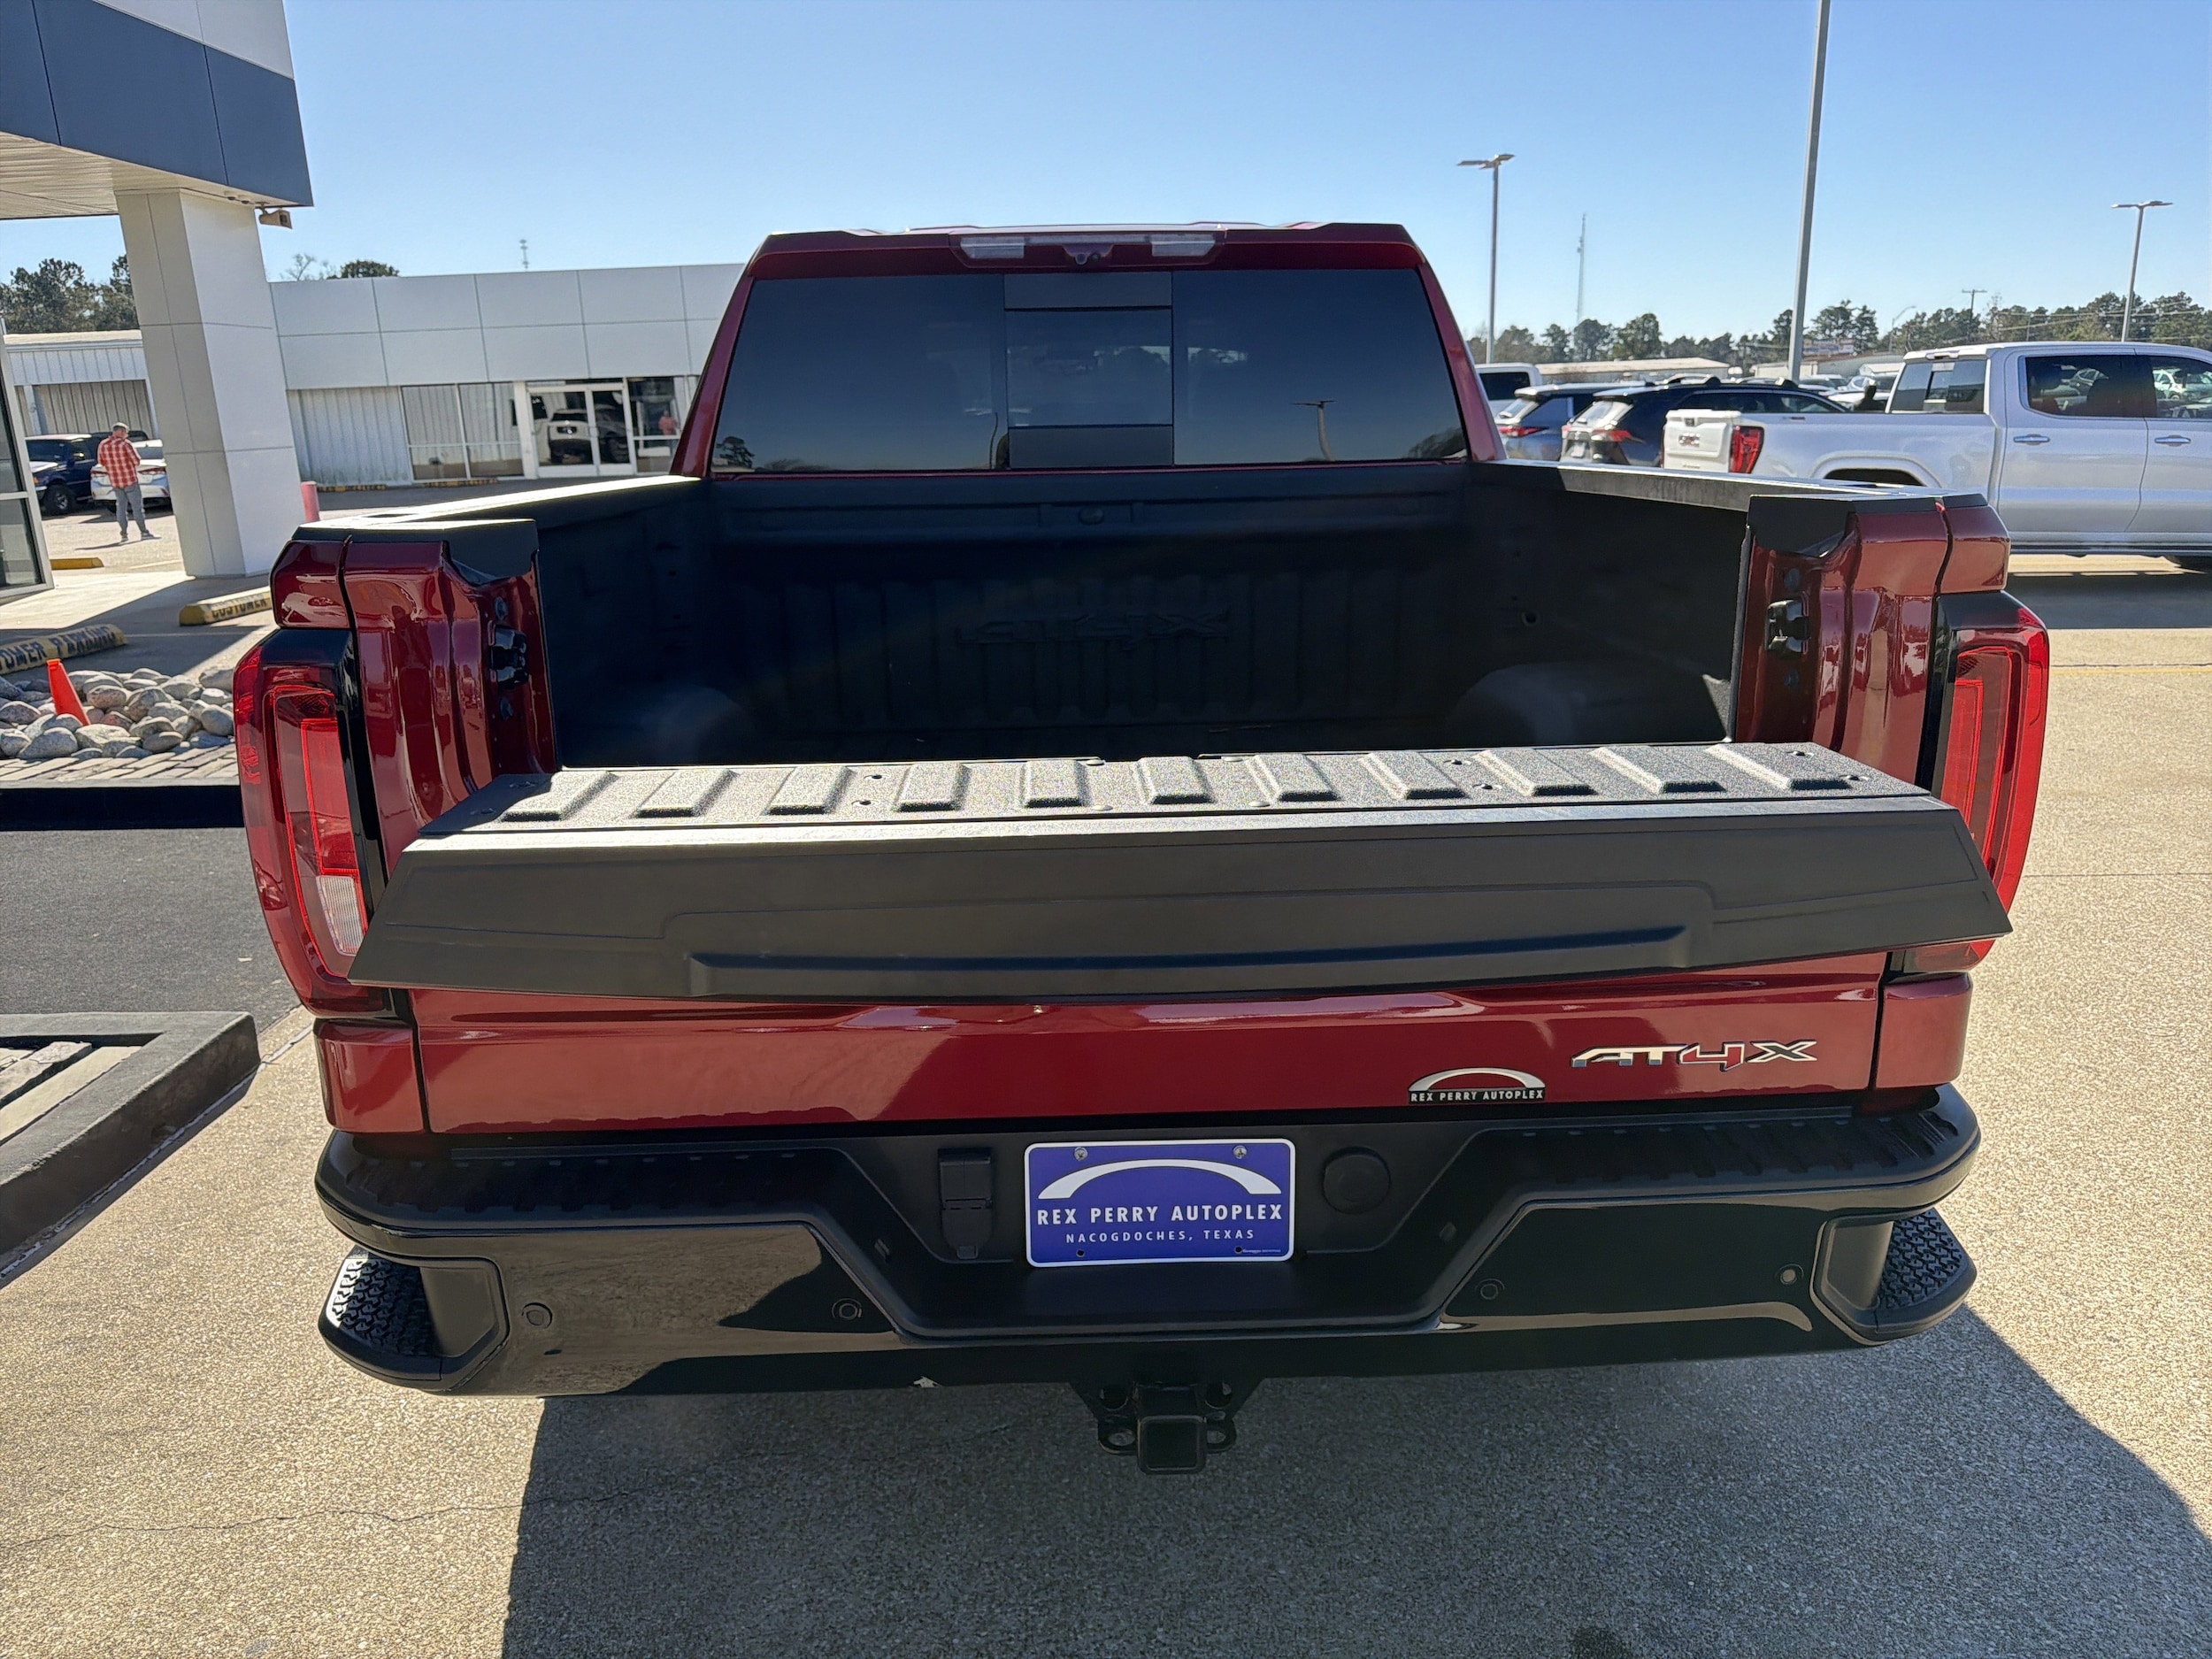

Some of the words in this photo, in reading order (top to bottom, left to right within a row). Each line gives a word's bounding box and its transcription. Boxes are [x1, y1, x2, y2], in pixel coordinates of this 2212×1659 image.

[1571, 1041, 1817, 1072] AT4X
[1410, 1093, 1433, 1102] REX
[1439, 1091, 1477, 1102] PERRY
[1482, 1089, 1543, 1100] AUTOPLEX
[1036, 1207, 1078, 1225] REX
[1090, 1205, 1159, 1224] PERRY
[1171, 1203, 1282, 1221] AUTOPLEX
[1065, 1229, 1194, 1244] NACOGDOCHES,
[1202, 1227, 1255, 1240] TEXAS
